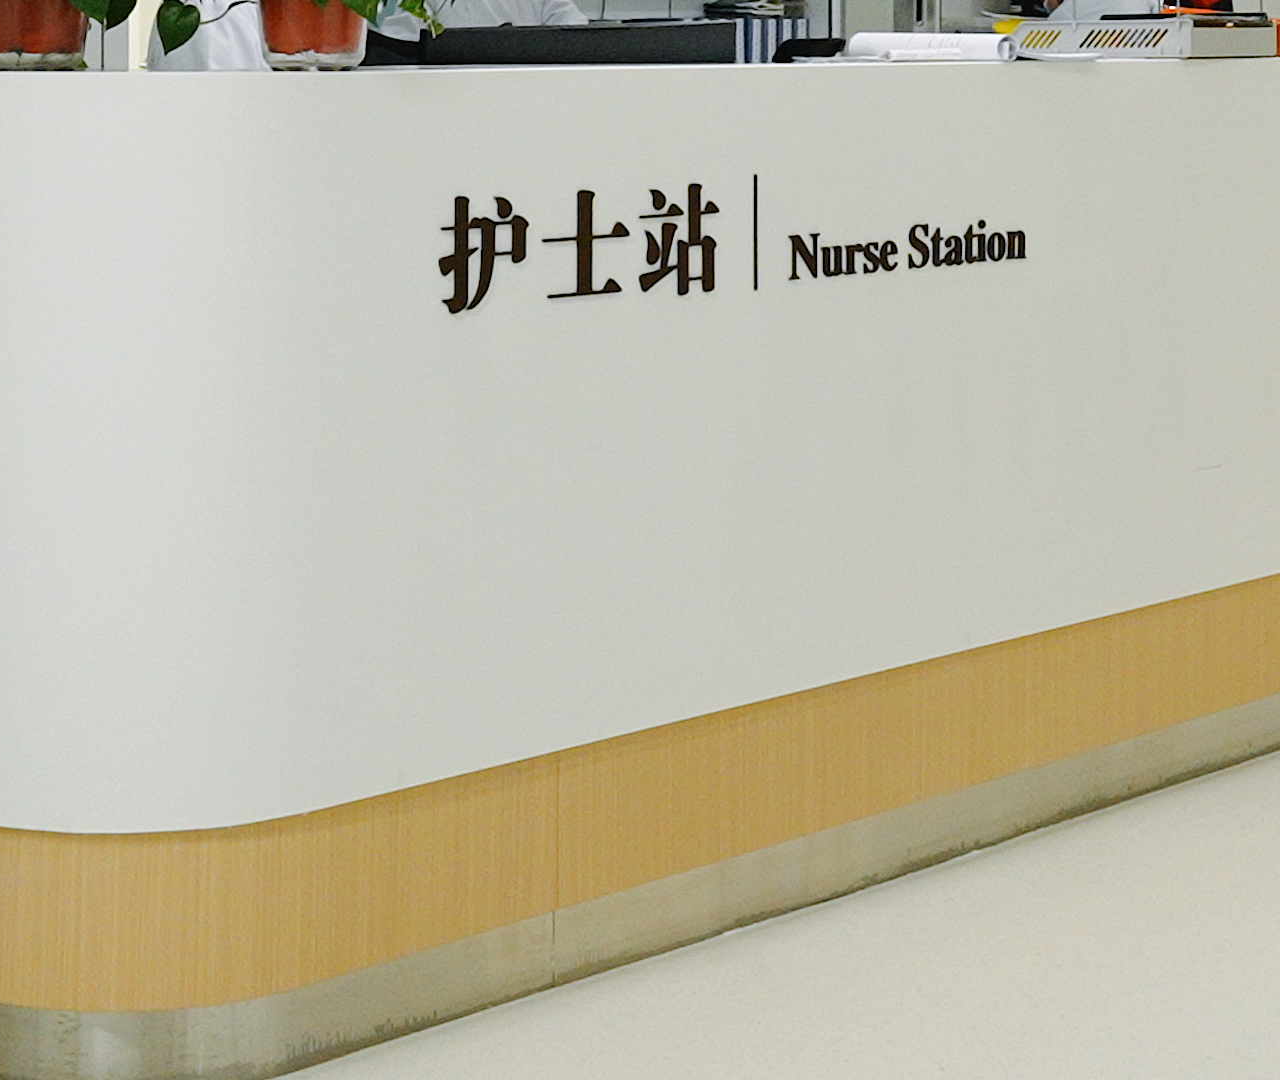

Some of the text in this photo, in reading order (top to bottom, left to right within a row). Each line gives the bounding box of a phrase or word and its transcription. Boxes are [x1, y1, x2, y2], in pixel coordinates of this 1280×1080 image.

[437, 182, 721, 314] 护士站
[789, 220, 1027, 280] Nurse Station
